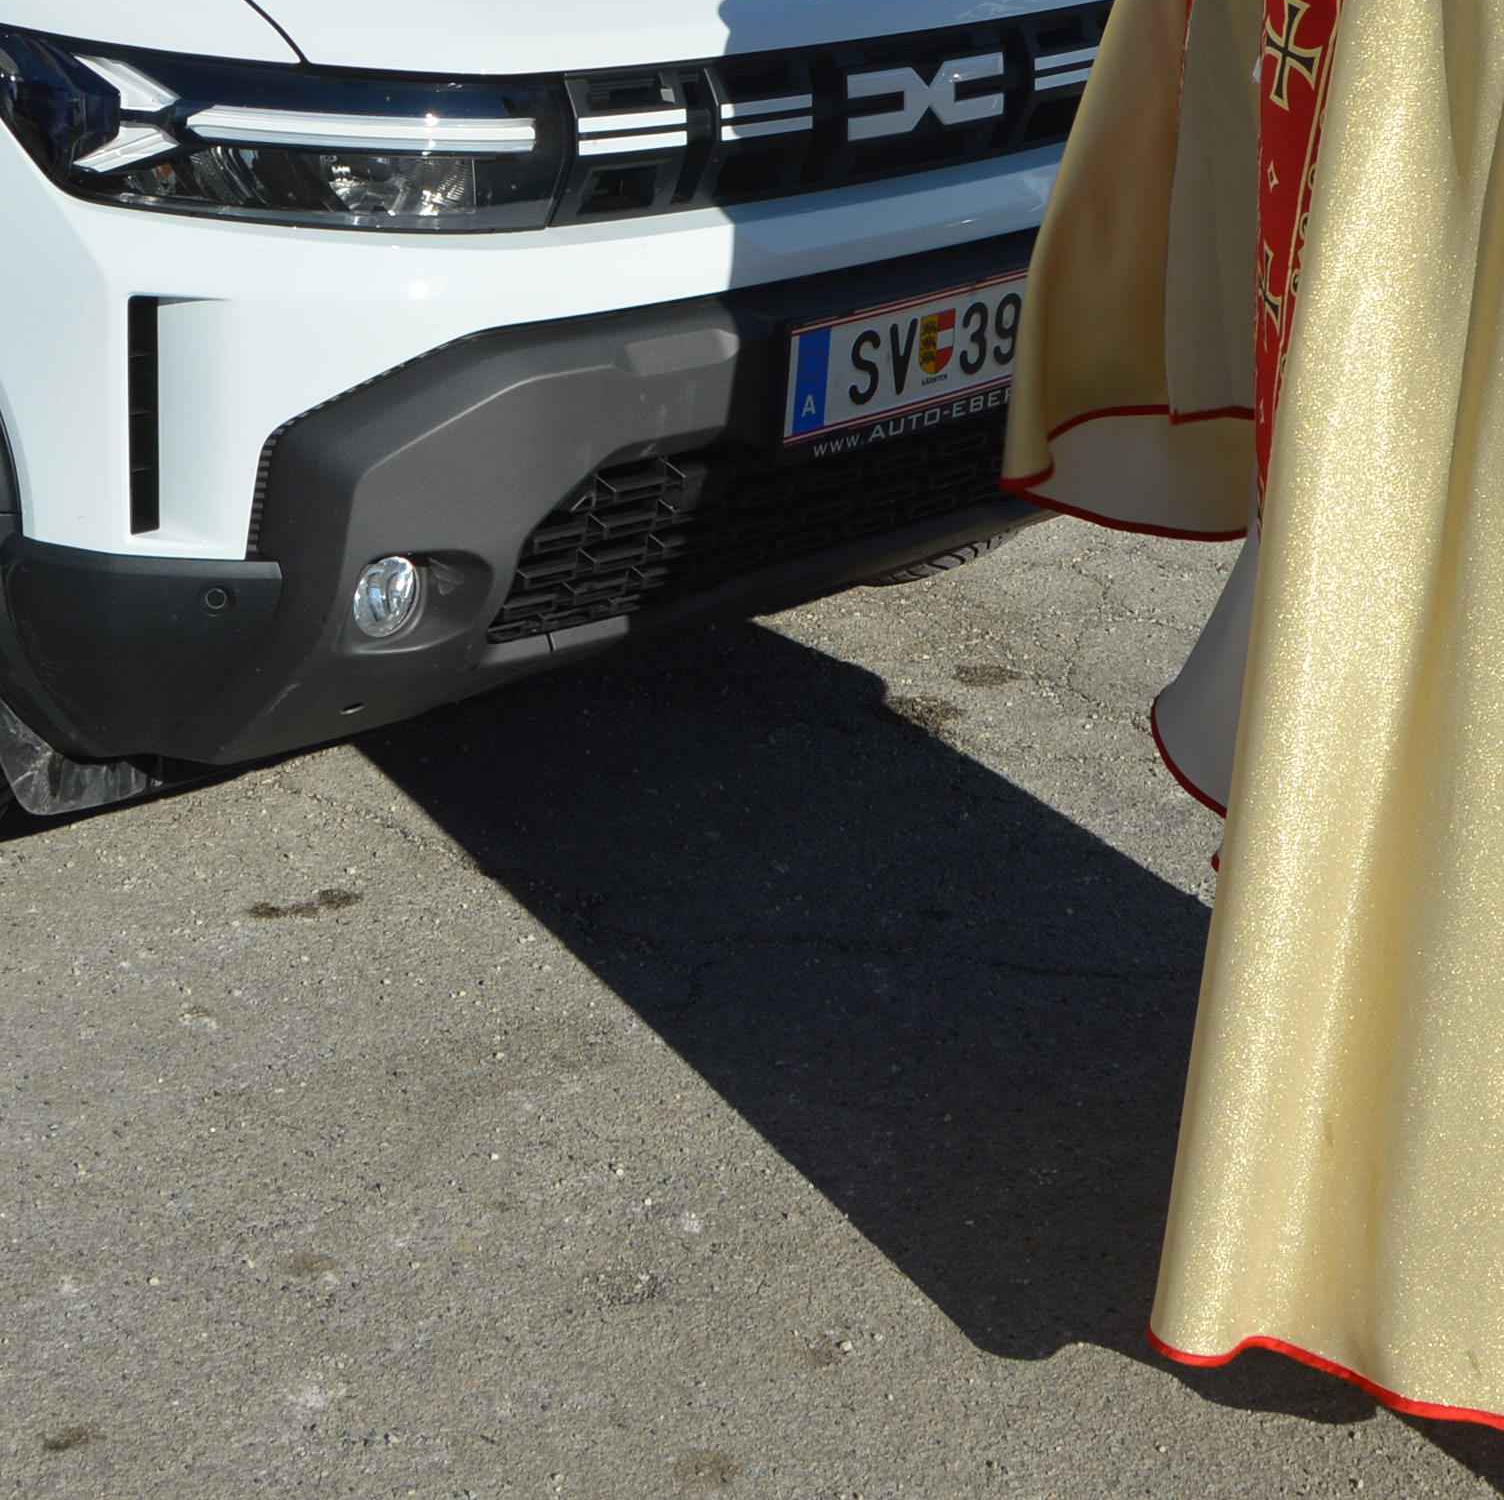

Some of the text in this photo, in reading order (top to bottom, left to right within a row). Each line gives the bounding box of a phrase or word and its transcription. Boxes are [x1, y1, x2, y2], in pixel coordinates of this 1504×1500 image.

[848, 292, 1022, 405] SV 39
[801, 395, 816, 417] A
